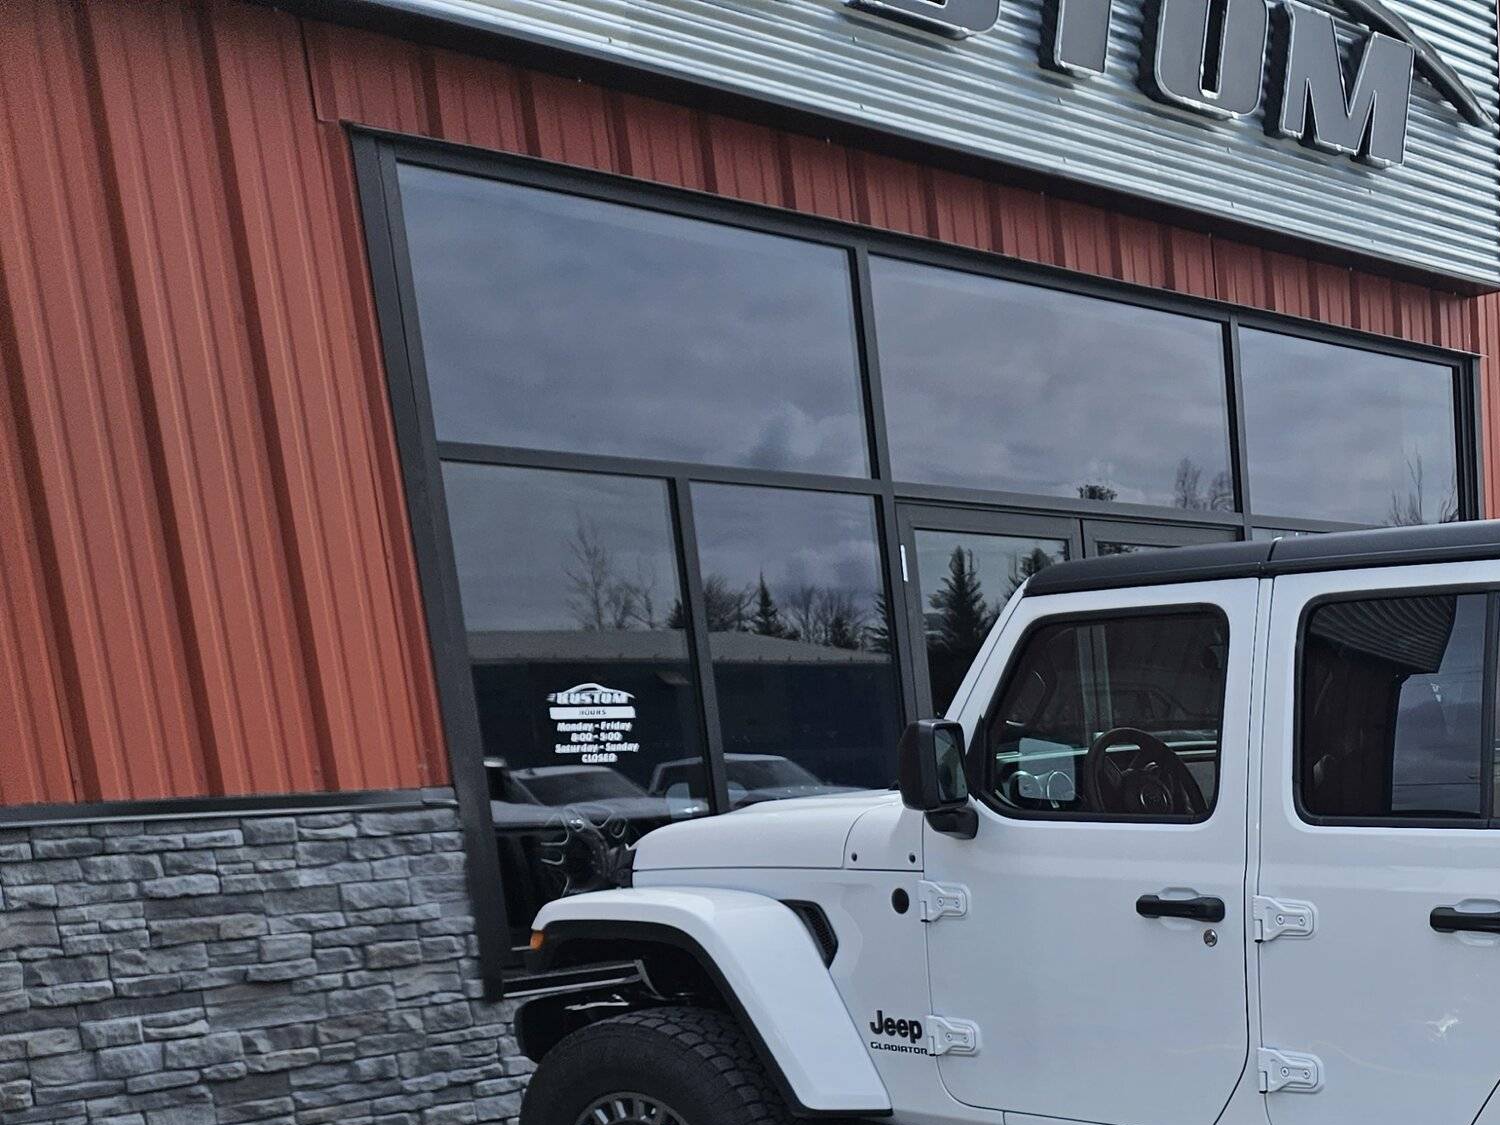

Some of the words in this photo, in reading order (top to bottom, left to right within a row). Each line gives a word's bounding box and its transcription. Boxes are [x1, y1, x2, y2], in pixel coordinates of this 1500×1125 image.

[556, 692, 629, 705] KUSTOM
[557, 722, 594, 732] Monday
[600, 721, 632, 732] Friday
[555, 743, 599, 754] Saturday
[605, 742, 640, 753] Sunday
[581, 752, 618, 763] CLOSED
[870, 1010, 922, 1044] Jeep
[870, 1041, 929, 1056] GLADIATOR
